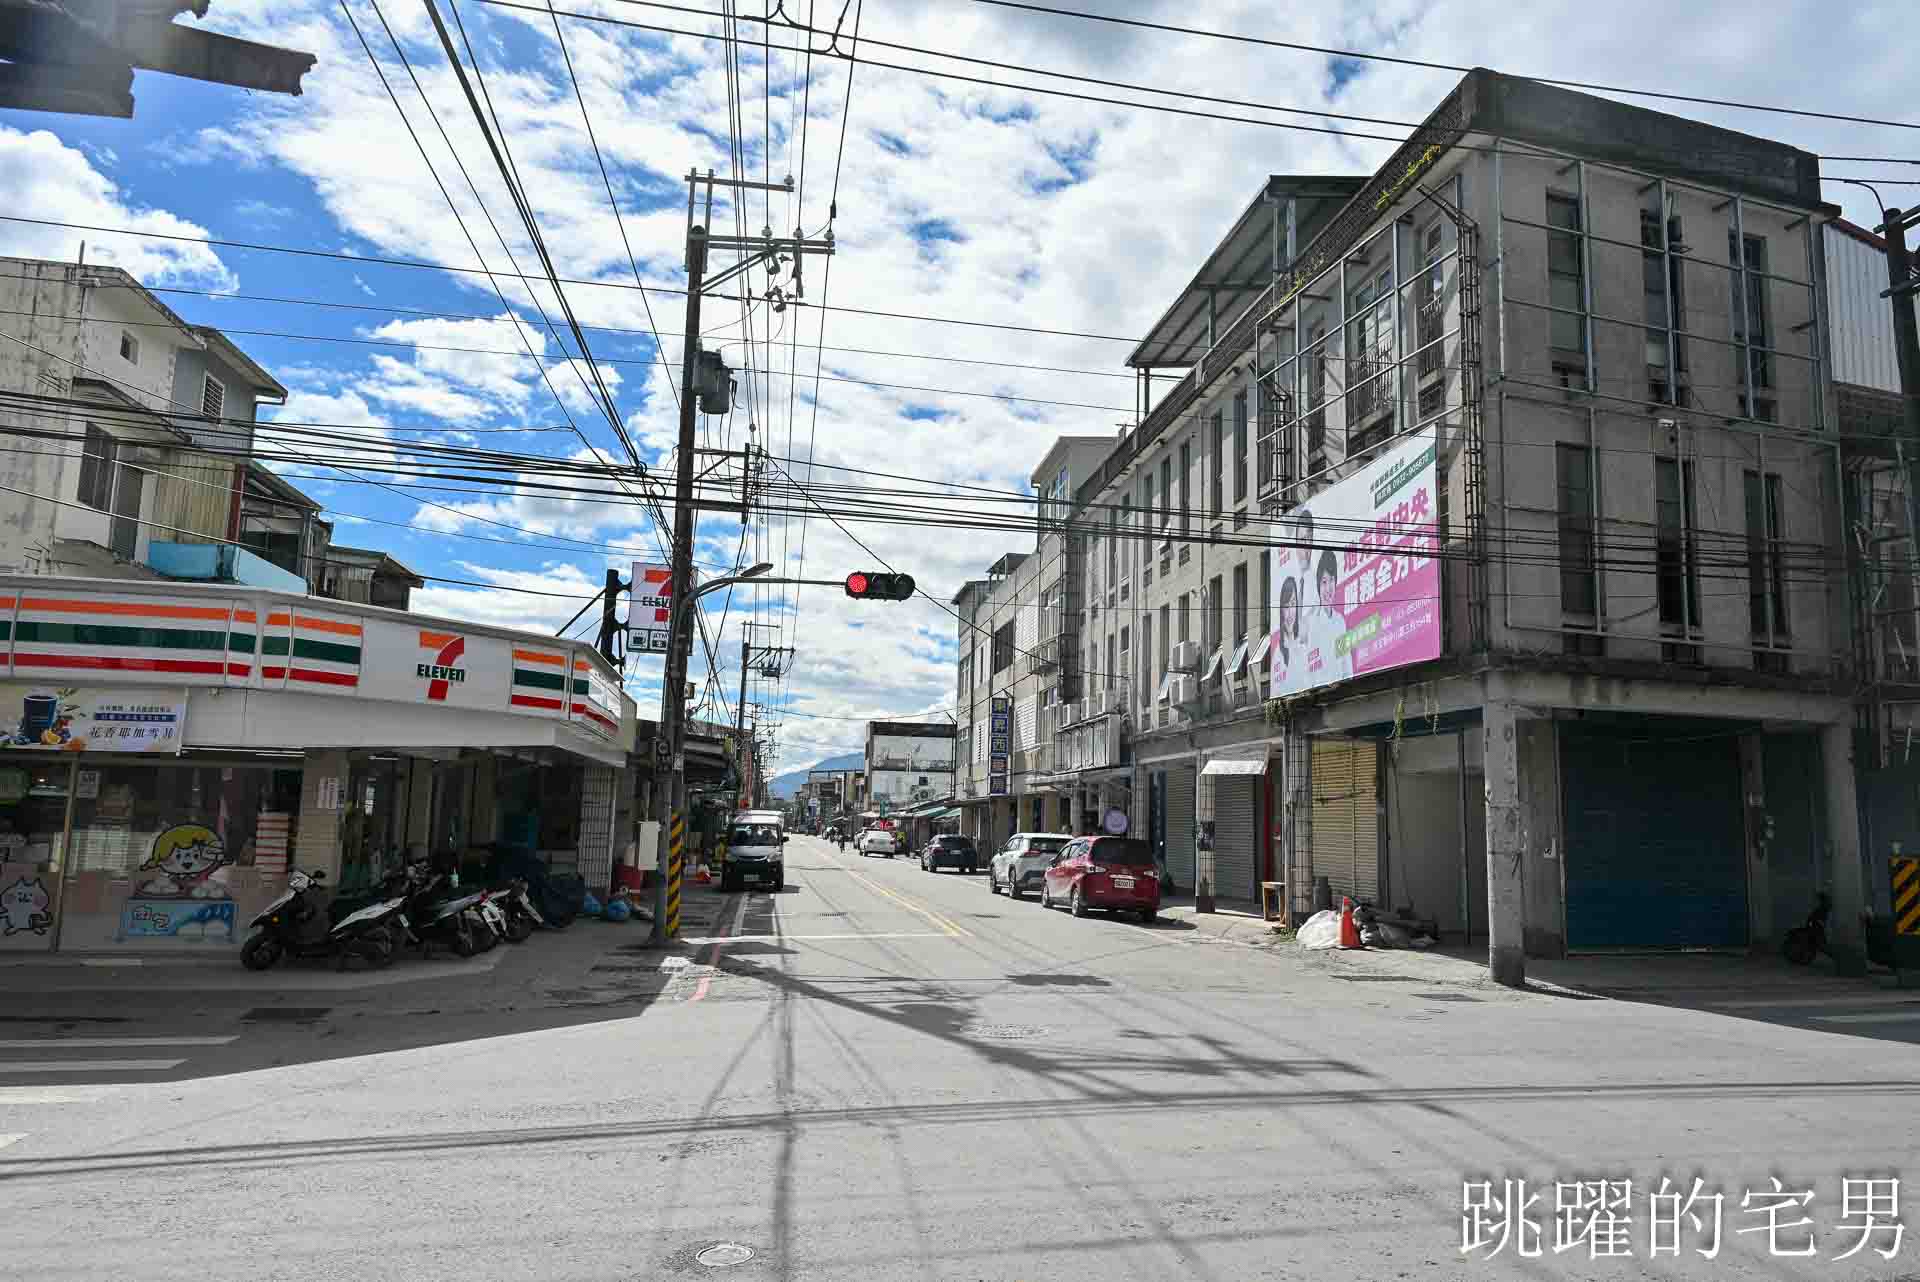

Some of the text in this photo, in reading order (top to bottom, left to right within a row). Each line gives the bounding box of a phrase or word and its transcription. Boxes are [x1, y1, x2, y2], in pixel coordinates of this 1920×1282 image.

[1344, 531, 1433, 616] 服務全方位
